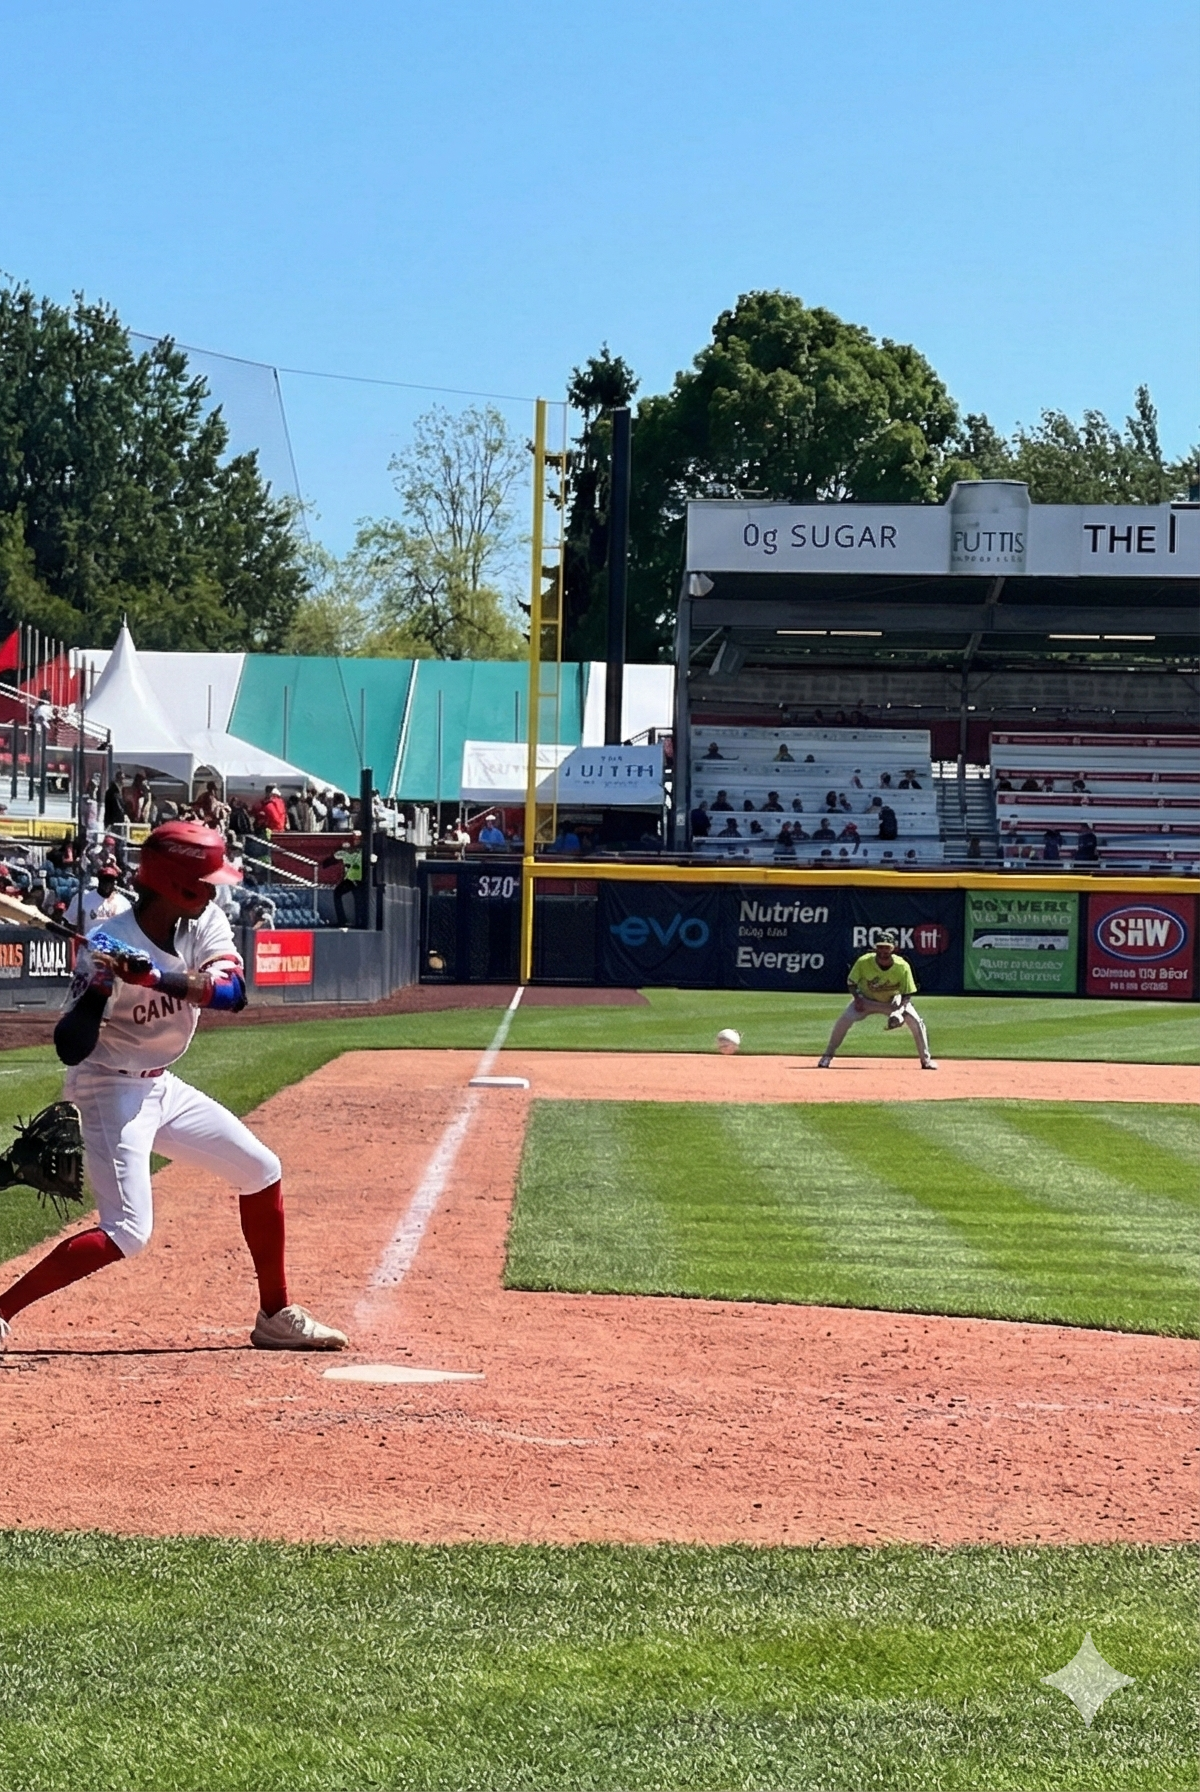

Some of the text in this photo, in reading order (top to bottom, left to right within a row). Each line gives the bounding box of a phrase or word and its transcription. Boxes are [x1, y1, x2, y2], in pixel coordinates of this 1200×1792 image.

[791, 524, 897, 549] SUGAR
[1083, 524, 1156, 553] THE
[739, 901, 829, 923] Nutrien
[610, 913, 709, 947] evo
[736, 946, 825, 973] Evergro
